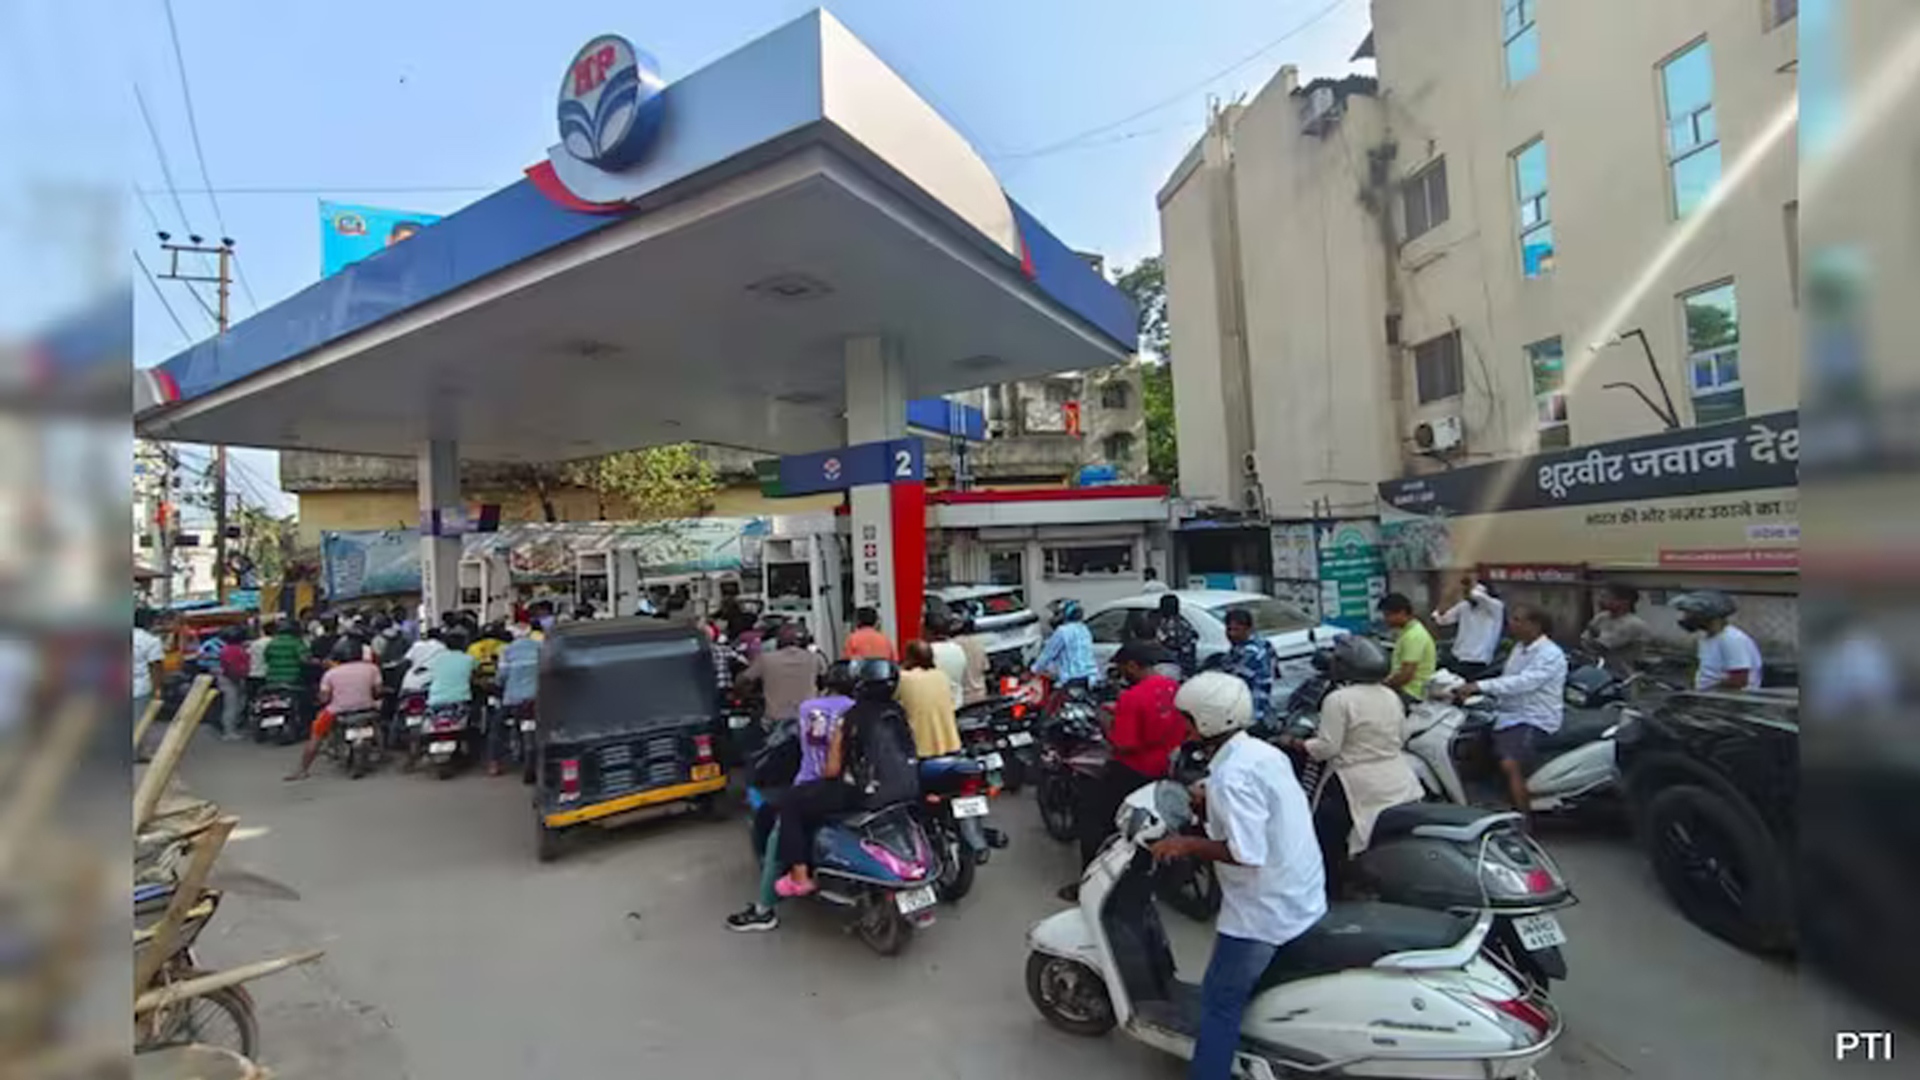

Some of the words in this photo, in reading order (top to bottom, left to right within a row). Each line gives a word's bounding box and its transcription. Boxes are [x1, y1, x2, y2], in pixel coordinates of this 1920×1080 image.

[574, 45, 616, 97] HP
[895, 451, 912, 476] 2
[1539, 450, 1624, 498] शूरवीर
[1629, 438, 1738, 478] जवान
[1620, 506, 1637, 524] की
